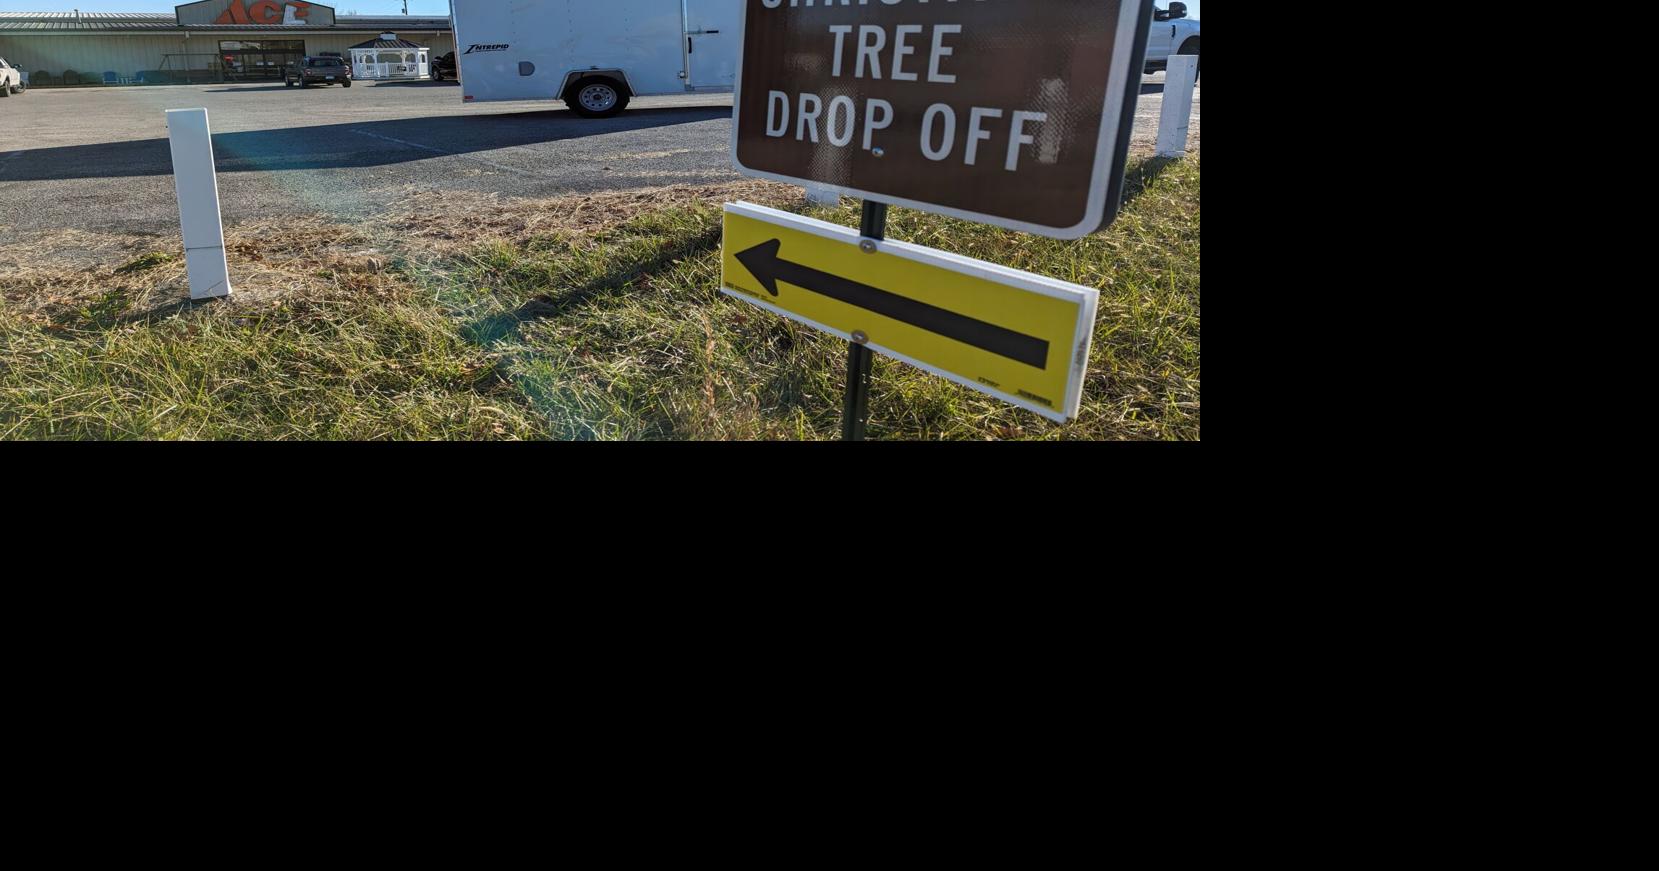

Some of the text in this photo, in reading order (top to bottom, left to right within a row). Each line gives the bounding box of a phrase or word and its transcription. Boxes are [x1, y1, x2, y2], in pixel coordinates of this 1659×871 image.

[214, 0, 310, 24] ACE
[463, 44, 510, 54] INTREPID
[829, 24, 962, 84] TREE
[765, 90, 1047, 171] DROP OFF
